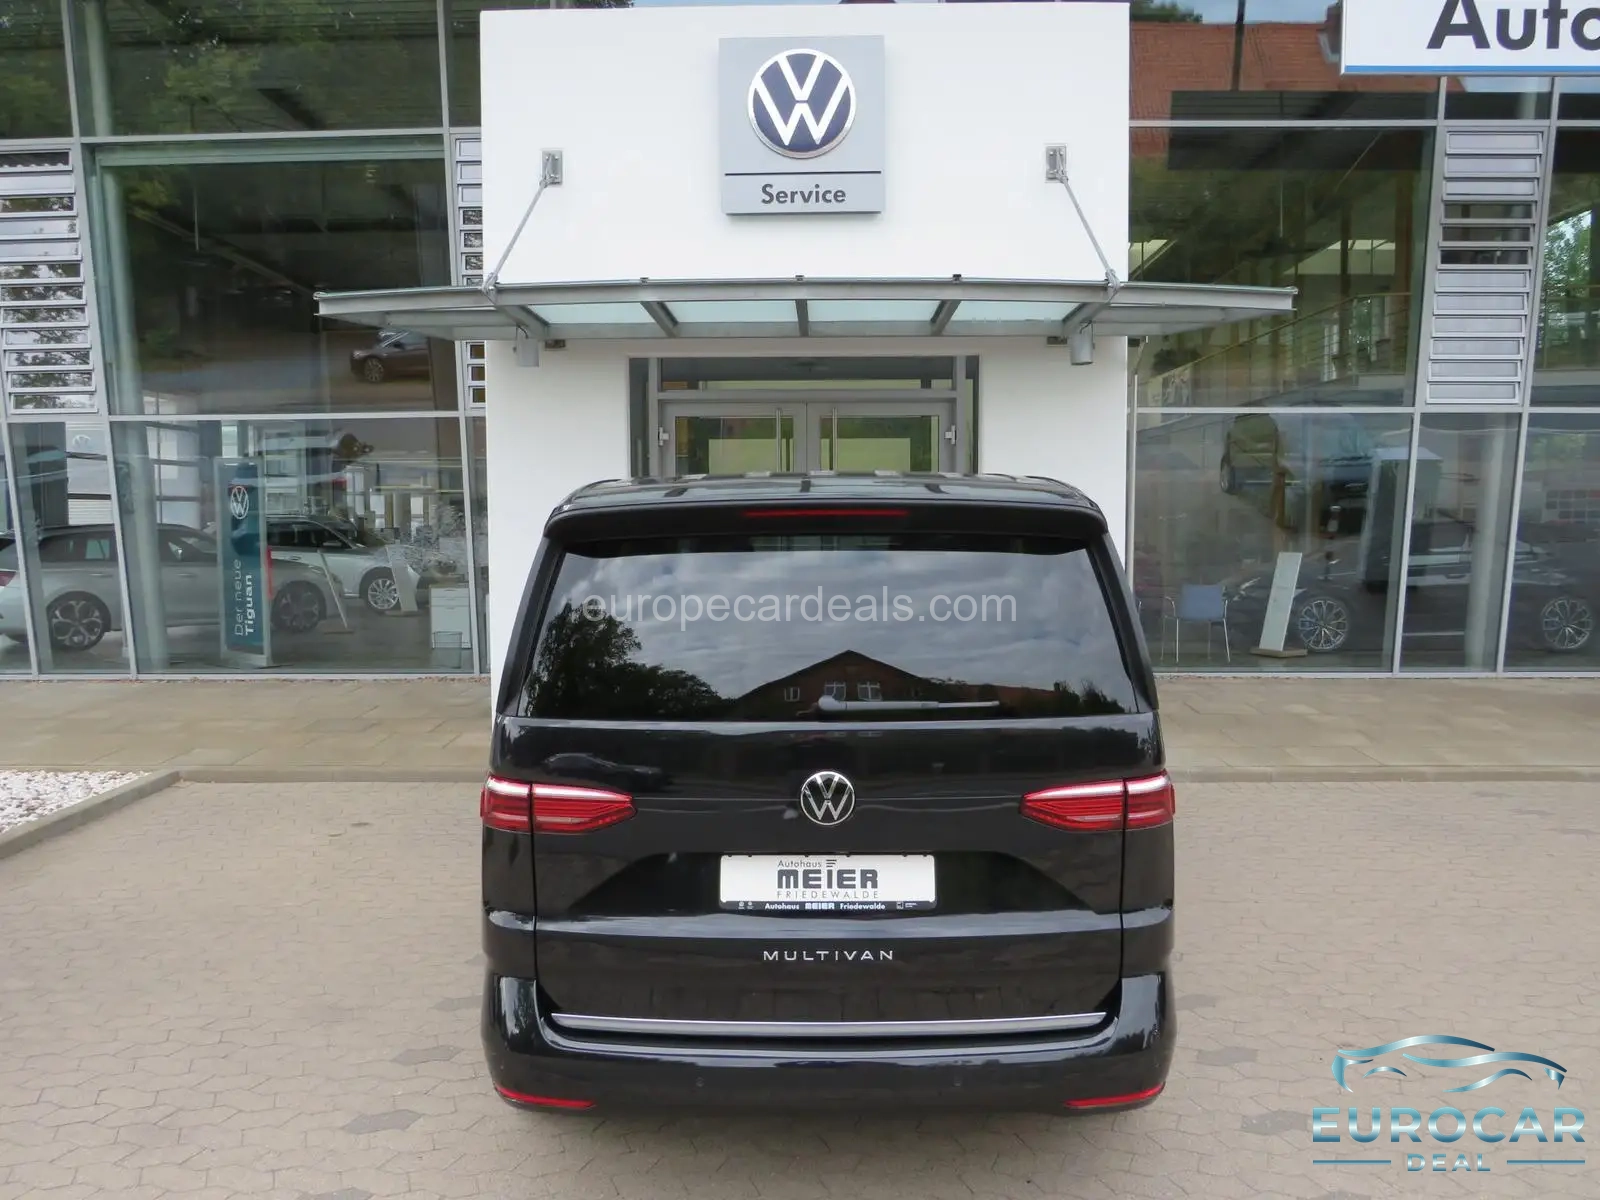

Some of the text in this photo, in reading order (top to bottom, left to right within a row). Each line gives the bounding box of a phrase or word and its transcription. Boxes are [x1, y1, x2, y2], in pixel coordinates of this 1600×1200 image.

[761, 183, 847, 205] Service
[244, 574, 256, 636] Tiguan
[234, 607, 243, 636] Der
[777, 859, 823, 868] Autohaus
[777, 868, 878, 889] MEIER
[777, 890, 879, 899] FRIEDEWALDE
[764, 902, 886, 910] Autohaus MEIER Friedewalde
[763, 950, 893, 961] MULTIVAN
